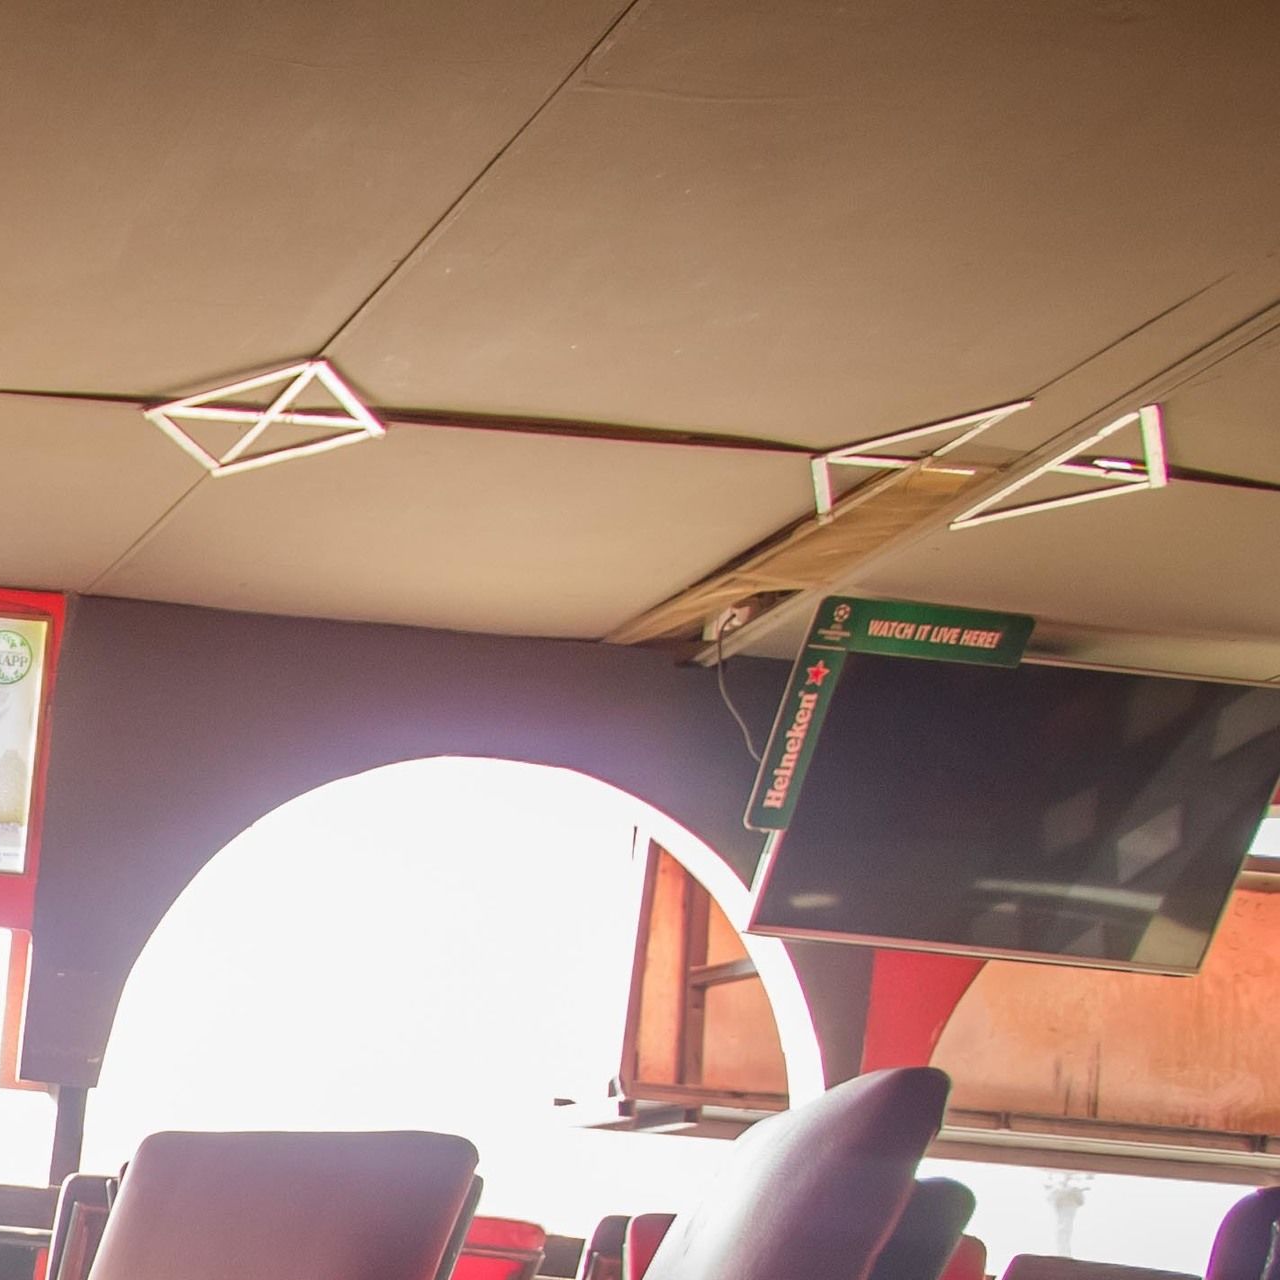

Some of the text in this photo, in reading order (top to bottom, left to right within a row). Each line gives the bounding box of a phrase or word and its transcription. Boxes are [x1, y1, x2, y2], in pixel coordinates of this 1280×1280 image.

[868, 619, 915, 640] WATCH
[914, 621, 931, 642] IT
[930, 625, 962, 645] LIVE
[960, 629, 1001, 648] HERE!
[763, 692, 818, 809] Heineken
